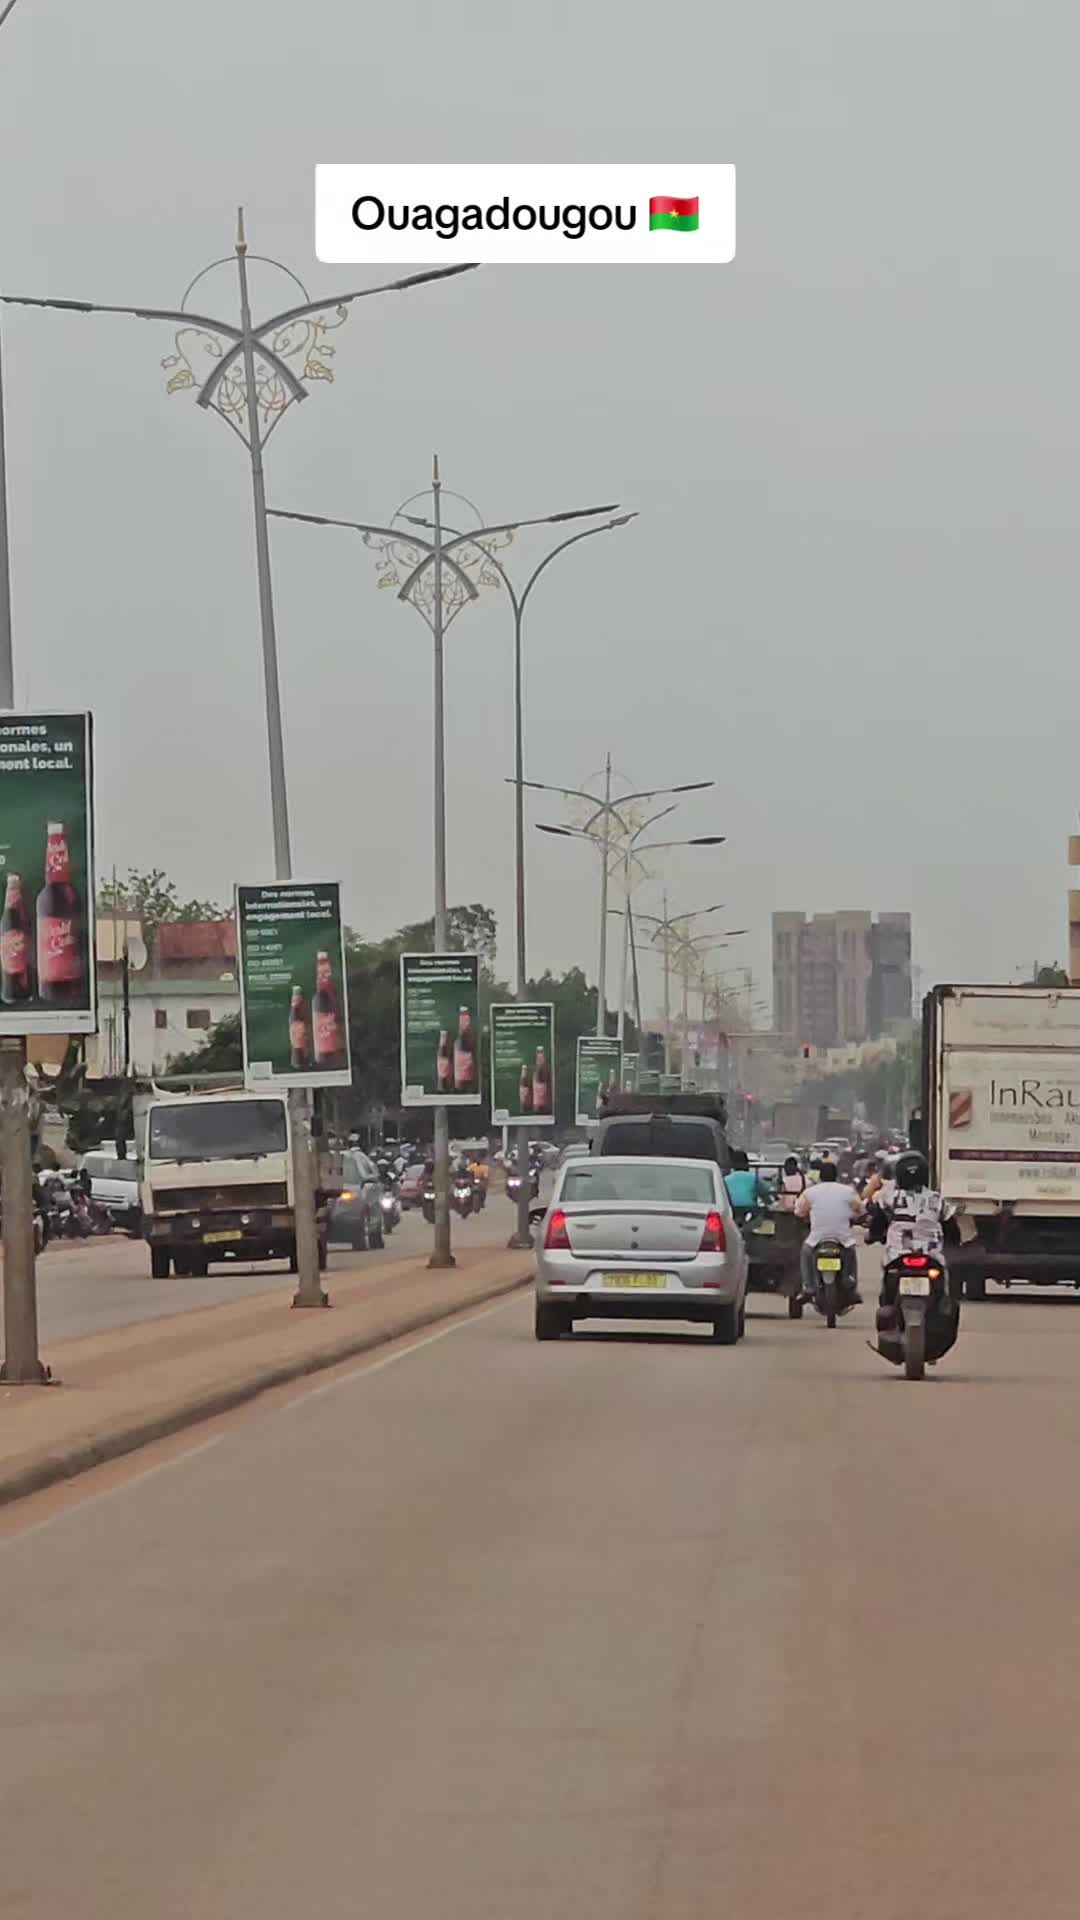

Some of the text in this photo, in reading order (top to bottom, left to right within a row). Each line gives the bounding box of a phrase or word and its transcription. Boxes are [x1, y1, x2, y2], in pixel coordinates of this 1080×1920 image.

[54, 741, 73, 752] un
[32, 756, 73, 769] local.
[990, 1079, 1080, 1109] InRau
